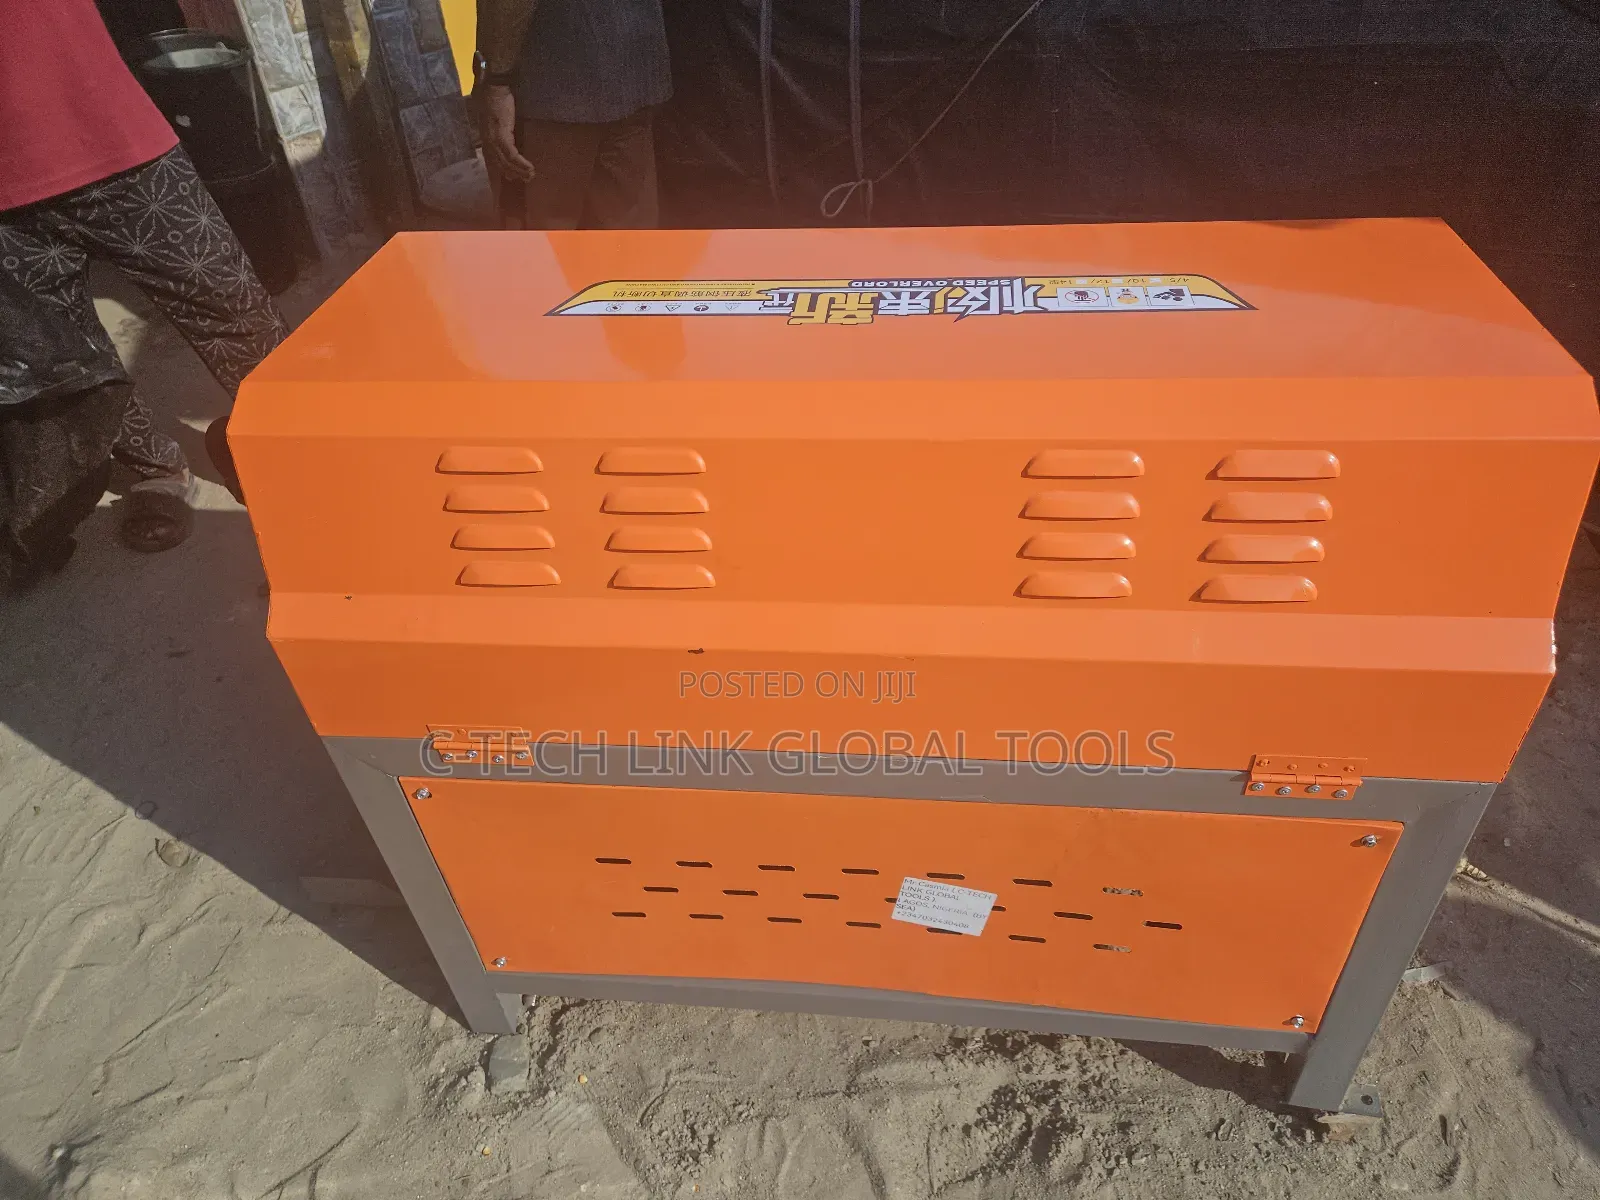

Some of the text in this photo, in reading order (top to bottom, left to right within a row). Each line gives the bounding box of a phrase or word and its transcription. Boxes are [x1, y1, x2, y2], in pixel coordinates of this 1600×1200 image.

[851, 279, 1013, 288] SPEED OVERLORD
[902, 885, 959, 901] LINK GLOBAL
[932, 904, 968, 916] NIGERIA
